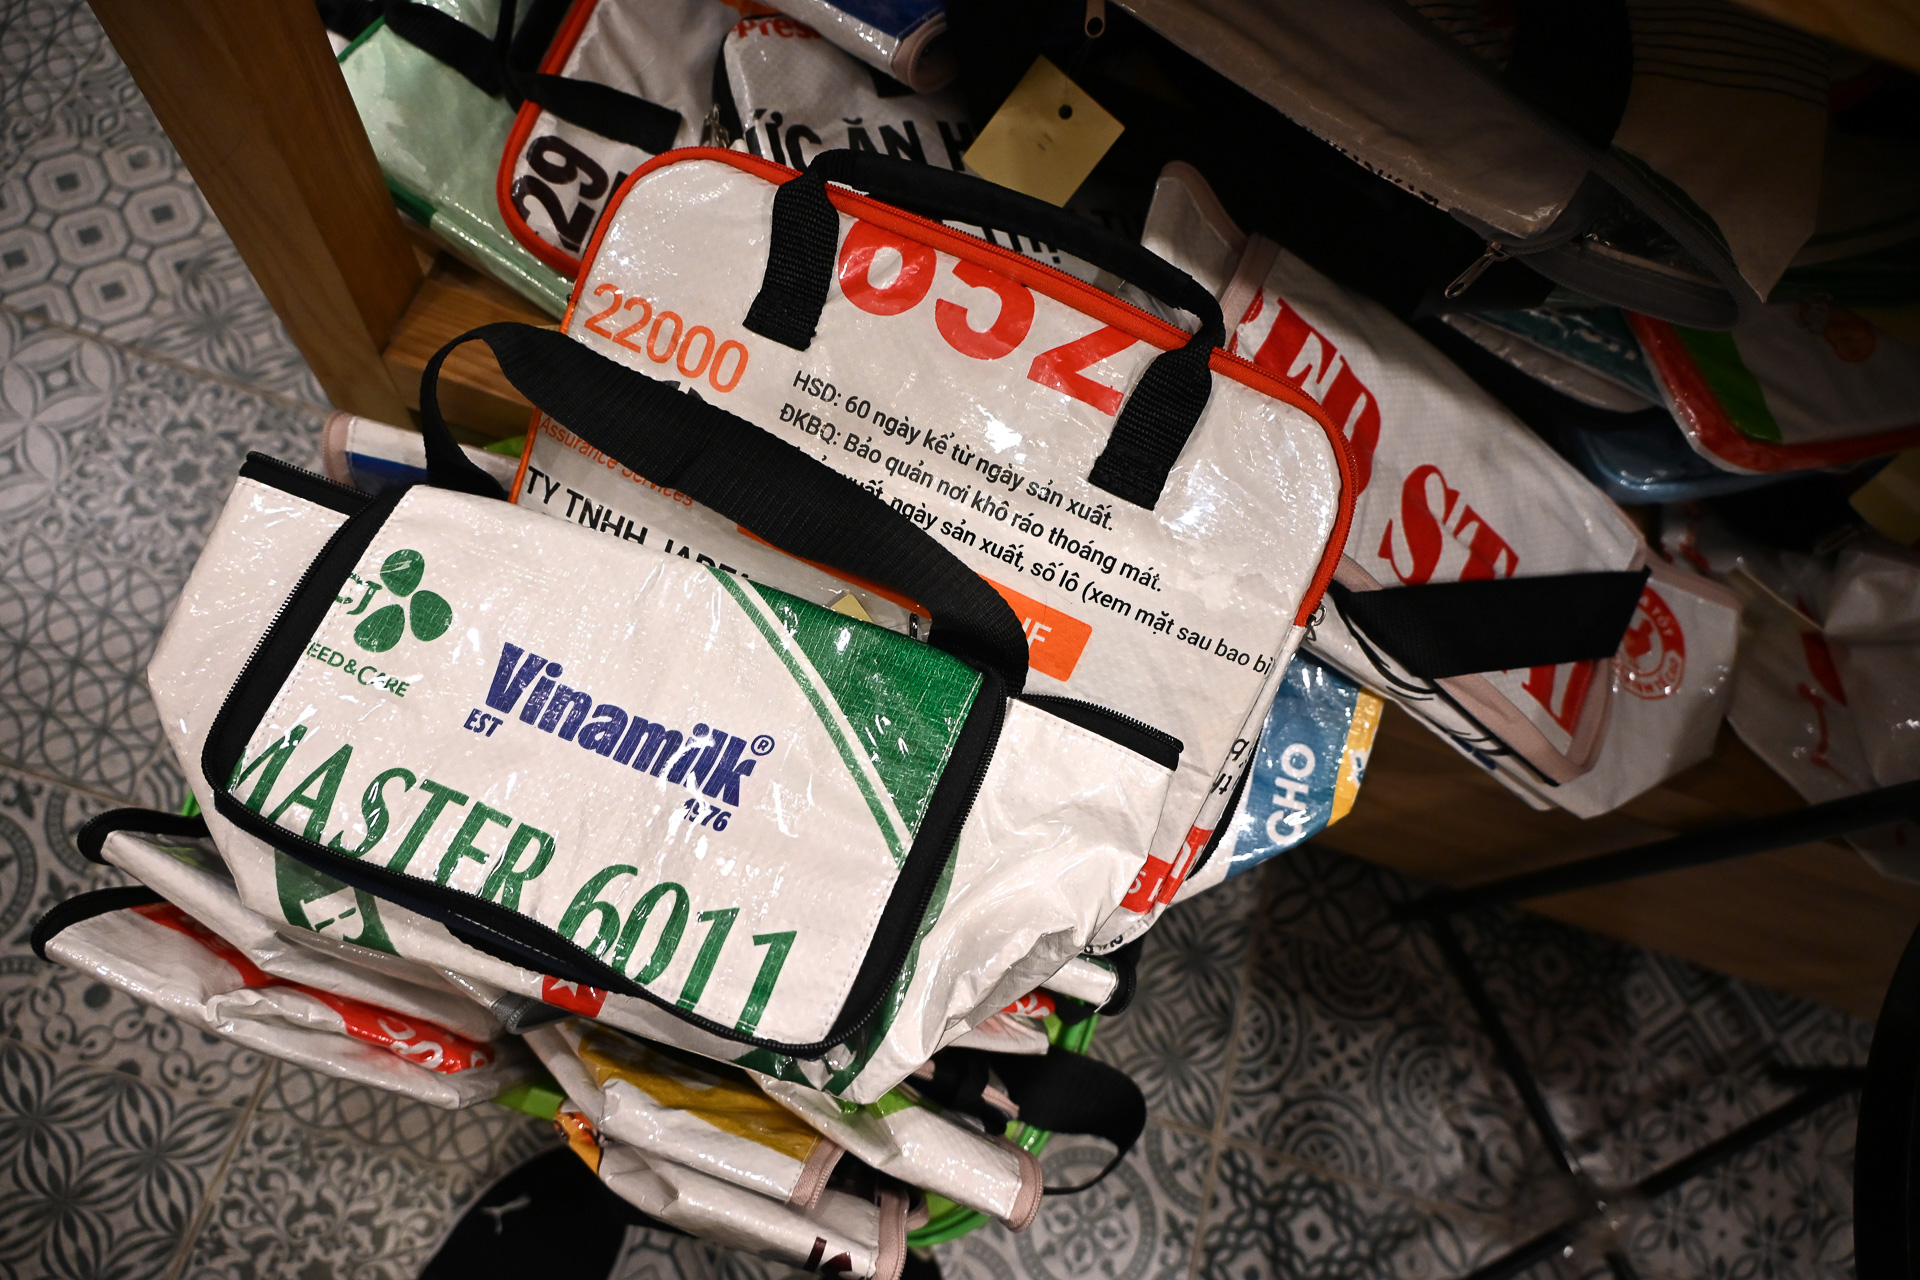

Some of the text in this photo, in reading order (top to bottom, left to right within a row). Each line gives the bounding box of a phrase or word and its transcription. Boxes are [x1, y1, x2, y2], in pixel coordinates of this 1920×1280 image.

[584, 283, 749, 393] 22000
[527, 466, 648, 546] TY TNHH
[779, 403, 1161, 592] ĐKBQ: Bảo quản nơi khô ráo thoáng mát.
[793, 370, 1113, 531] HSD: 60 ngày kể từ ngày sản xuất.
[890, 497, 938, 531] ngày
[940, 519, 976, 546] sản
[979, 538, 1024, 572] xuất,
[1030, 562, 1064, 582] số
[1058, 570, 1080, 592] lô
[1082, 581, 1132, 617] (xem
[1135, 608, 1175, 635] mặt
[1176, 627, 1213, 651] sau
[1214, 638, 1250, 666] bao
[463, 708, 504, 737] EST
[558, 864, 797, 1036] 6011
